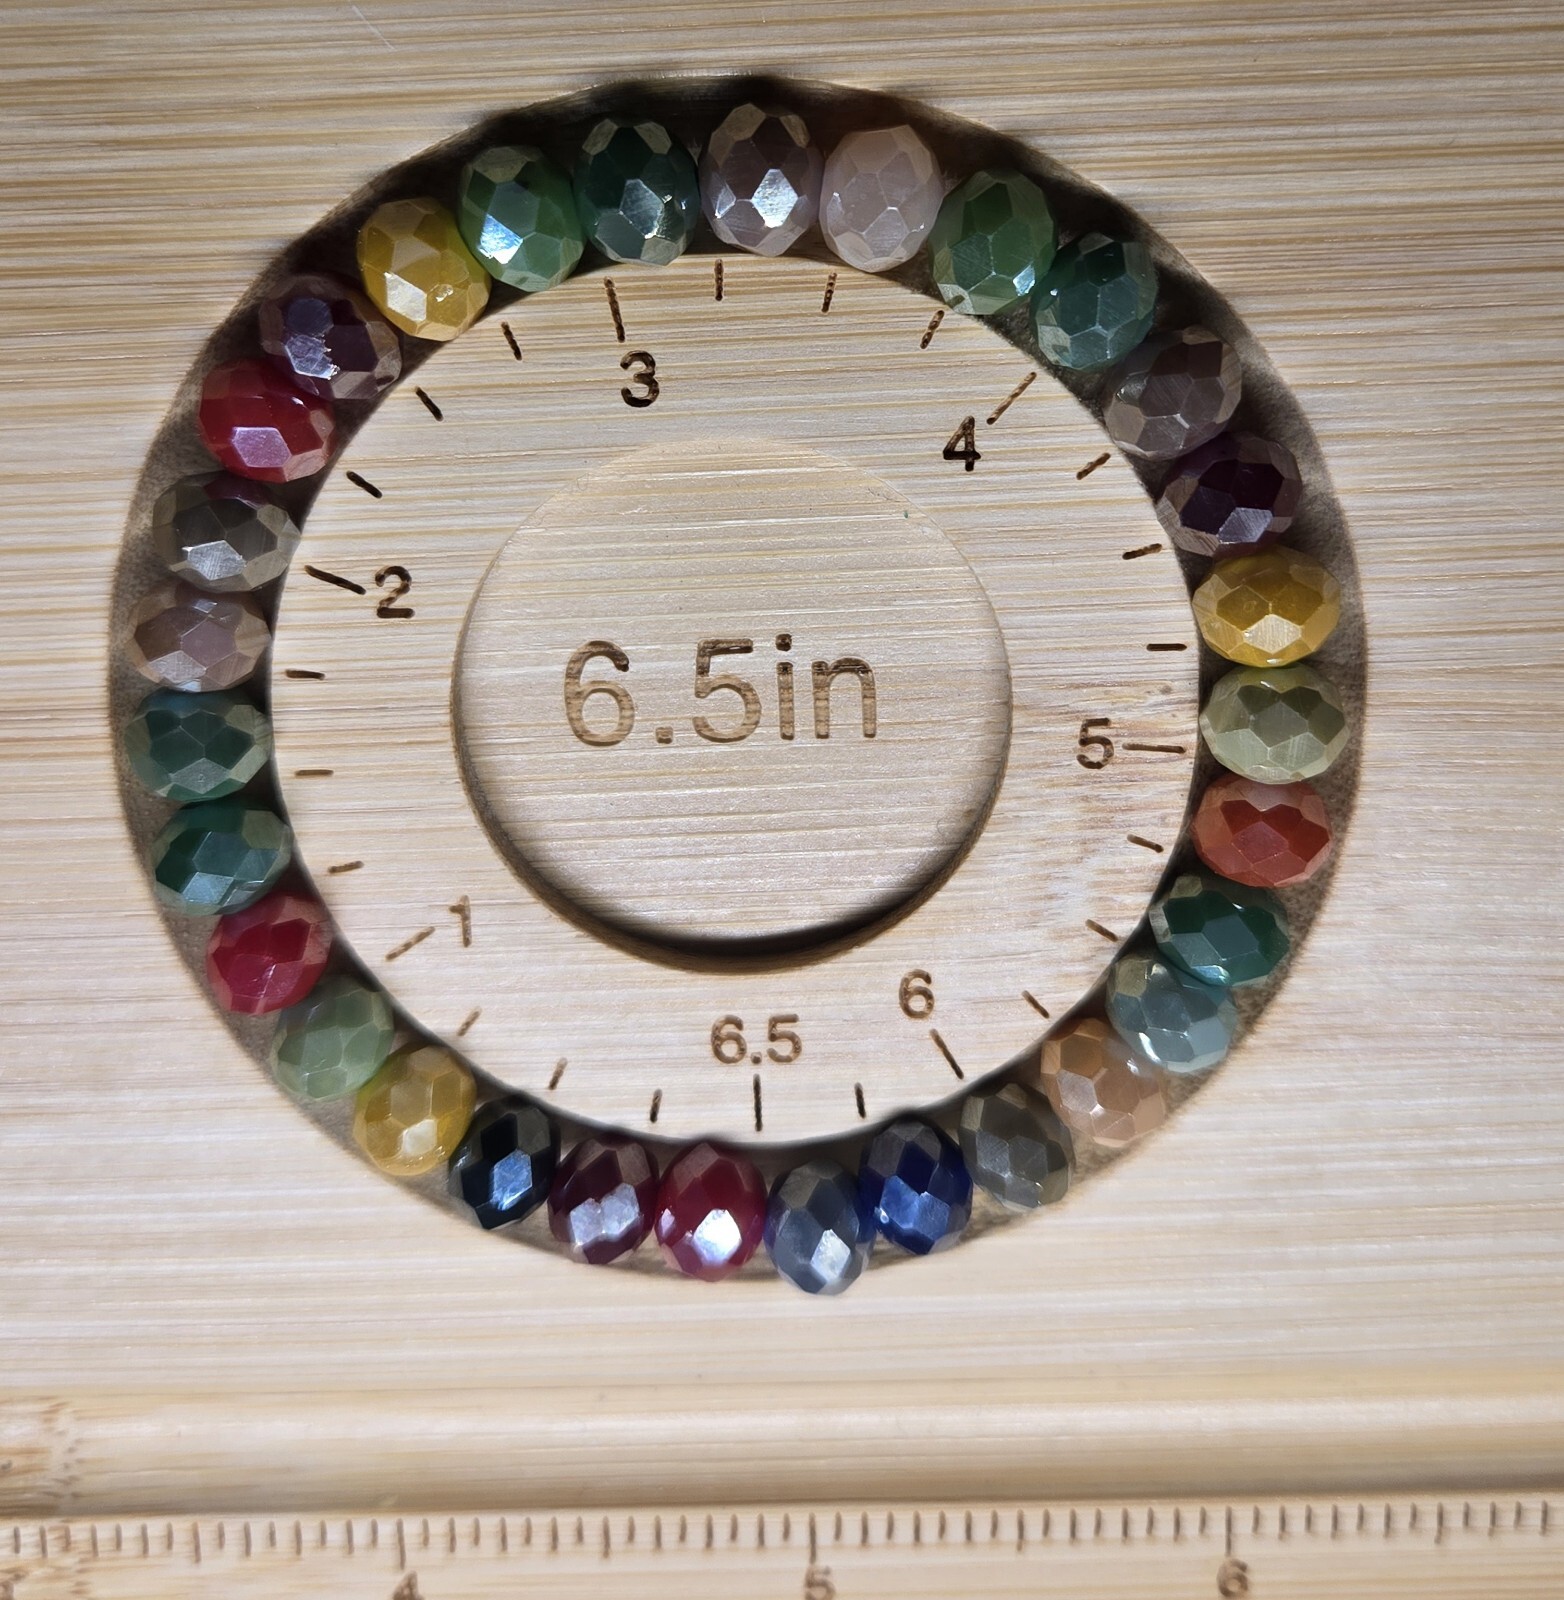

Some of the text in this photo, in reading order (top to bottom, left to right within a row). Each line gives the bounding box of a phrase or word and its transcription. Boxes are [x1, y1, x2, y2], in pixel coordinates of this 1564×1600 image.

[620, 350, 660, 407] 3
[942, 415, 981, 471] 4
[374, 565, 414, 618] 2
[563, 633, 877, 746] 6.5in
[1076, 717, 1114, 769] 5
[450, 895, 472, 947] 1
[899, 969, 935, 1020] 6
[711, 1014, 802, 1065] 6.5
[803, 1566, 836, 1600] 5
[1216, 1558, 1249, 1598] 6
